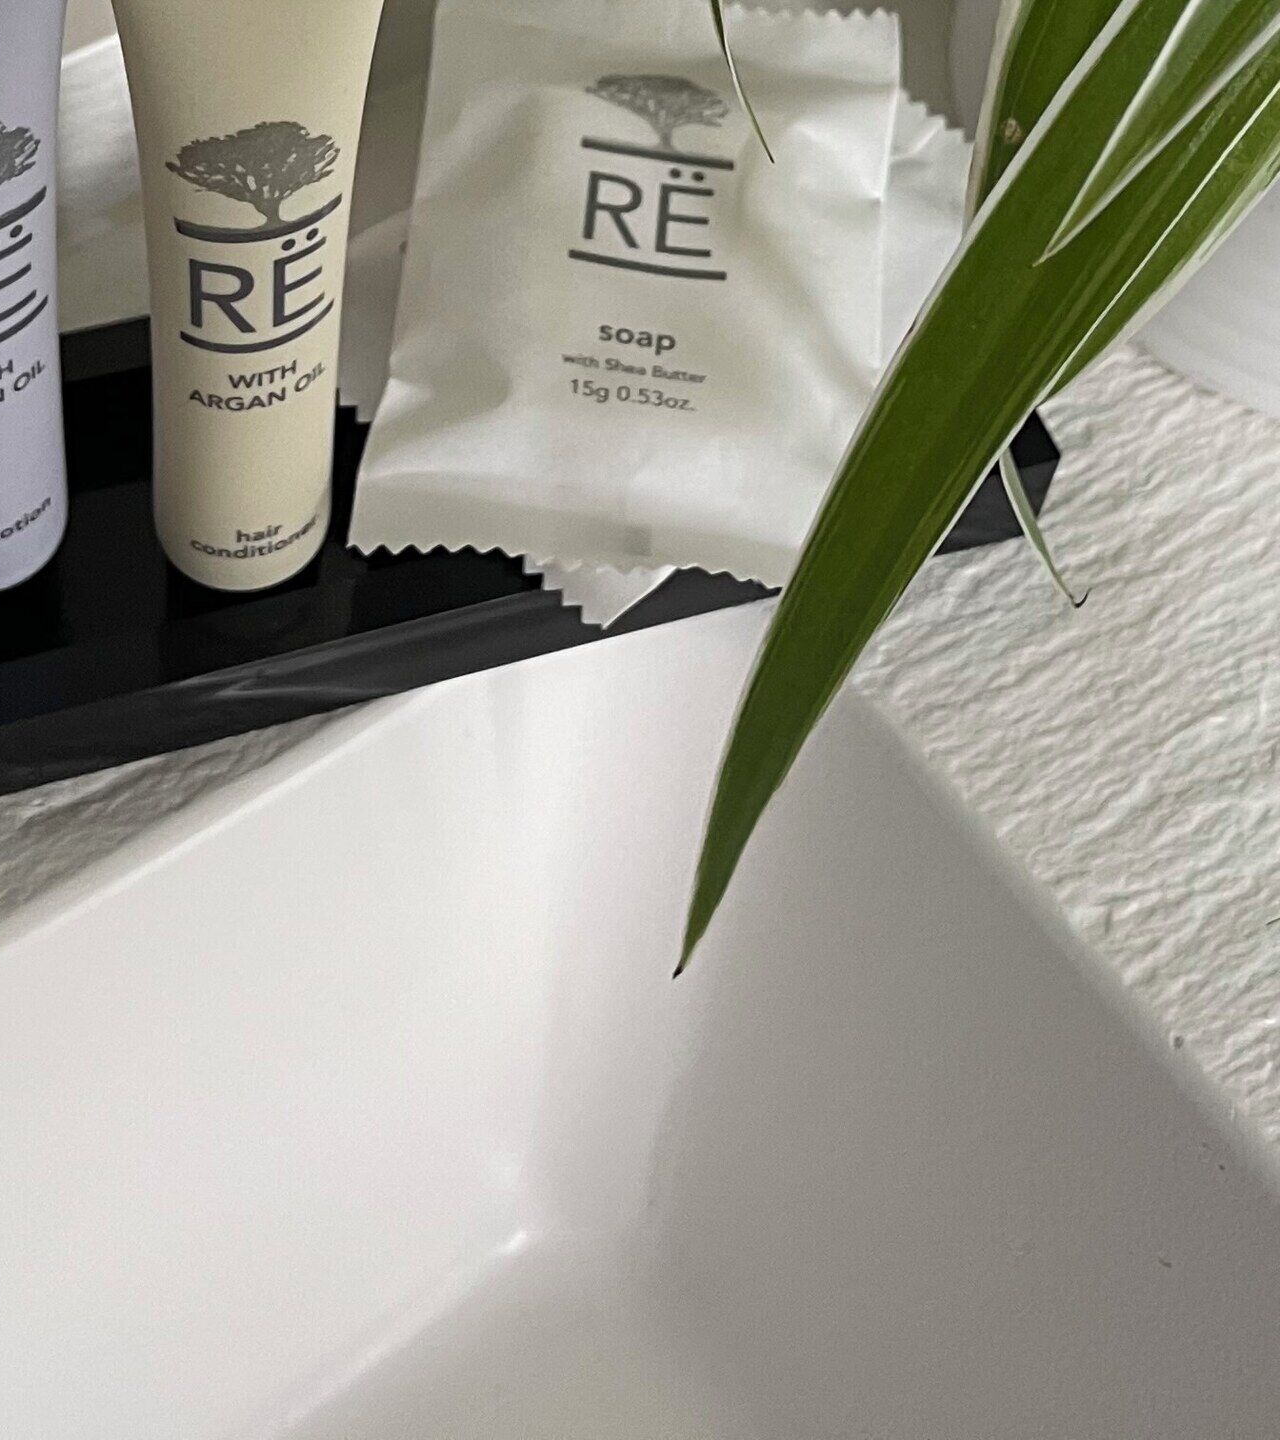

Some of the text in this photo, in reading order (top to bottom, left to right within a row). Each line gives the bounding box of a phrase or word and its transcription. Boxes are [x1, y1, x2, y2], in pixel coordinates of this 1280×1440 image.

[582, 167, 714, 258] RË
[188, 227, 327, 334] RË
[598, 323, 676, 356] soap
[13, 360, 45, 392] OIL
[189, 361, 326, 411] ARGAN OIL
[228, 359, 297, 389] WITH
[604, 357, 647, 376] Shea
[651, 364, 708, 384] Butter
[570, 378, 610, 404] 15g
[236, 524, 283, 543] hair
